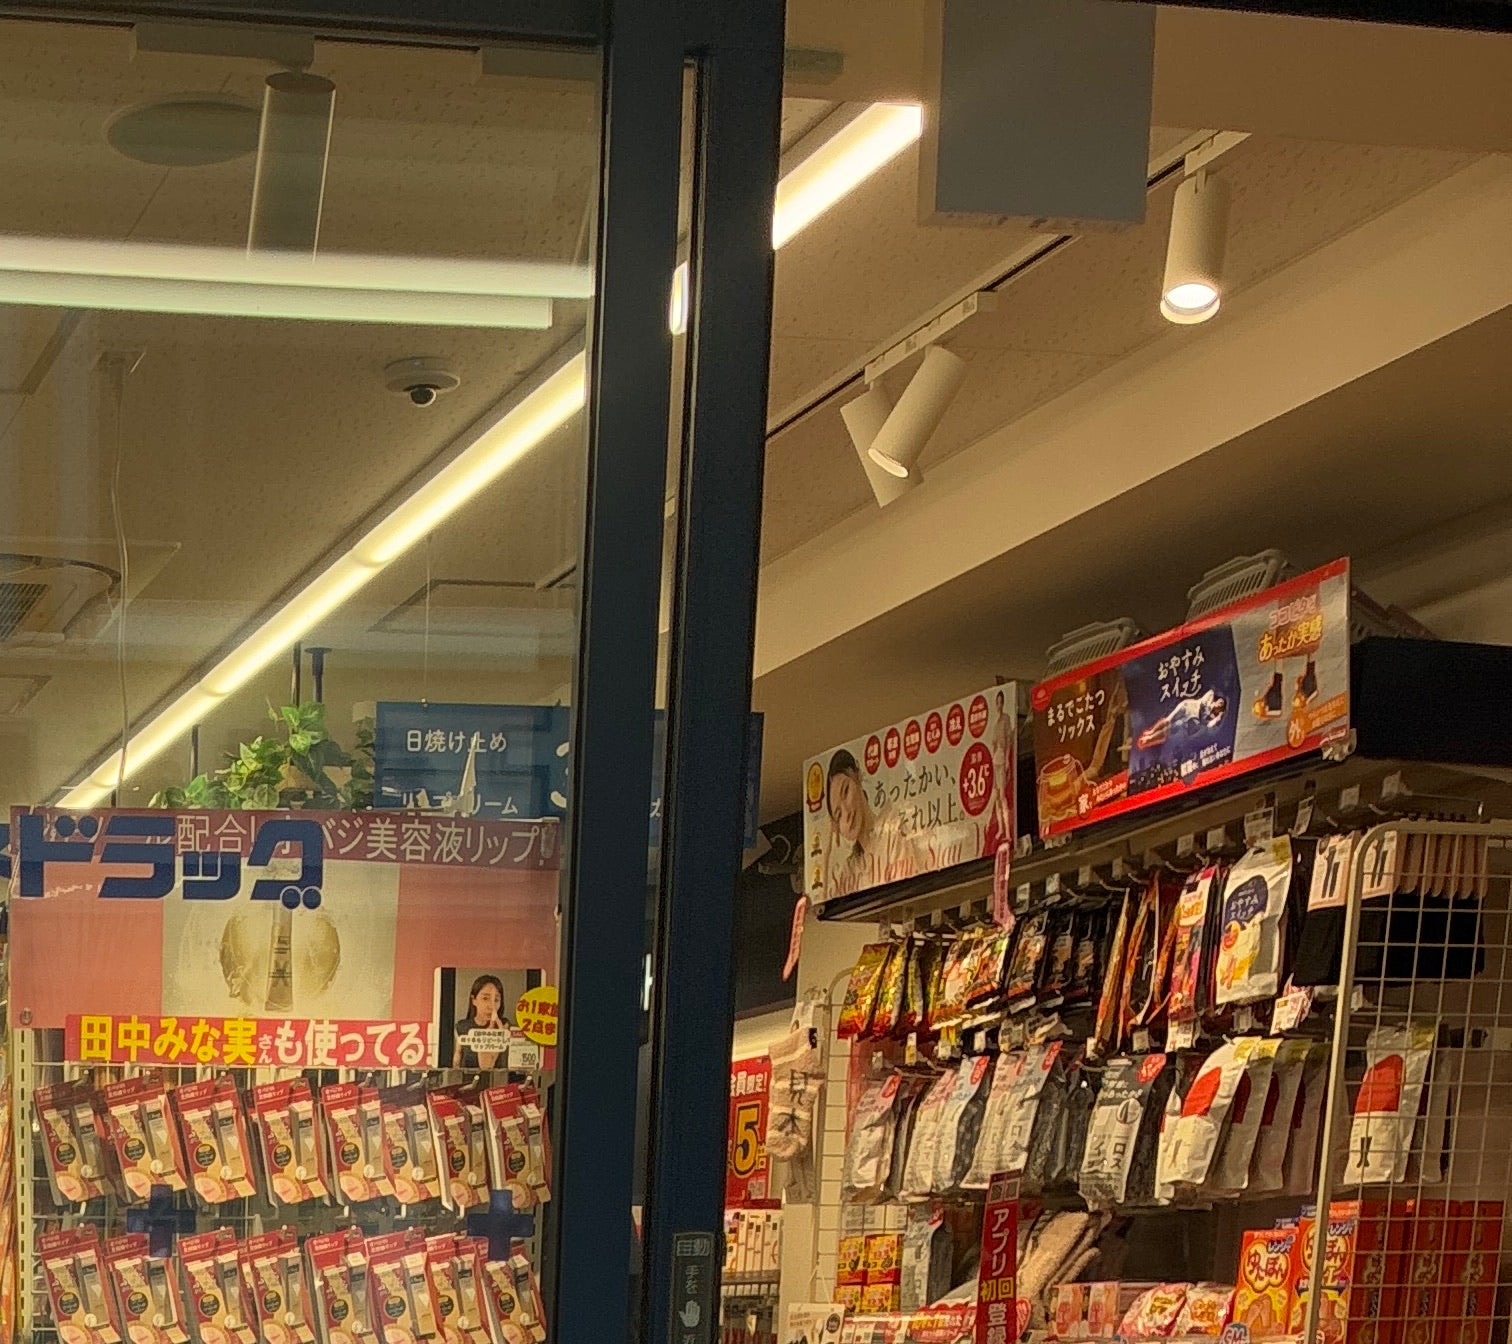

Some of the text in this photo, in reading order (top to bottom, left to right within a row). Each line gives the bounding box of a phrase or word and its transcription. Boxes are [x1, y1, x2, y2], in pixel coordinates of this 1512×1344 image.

[1157, 645, 1205, 681] おやすみ
[1047, 689, 1105, 728] まるでこたつ
[407, 730, 507, 753] 日焼け止め
[1058, 715, 1096, 743] ソックス
[79, 1015, 435, 1066] 田中みな実さんも使ってる!
[735, 1104, 759, 1175] 5
[991, 1208, 1010, 1276] アプリ
[980, 1278, 1014, 1300] 初回
